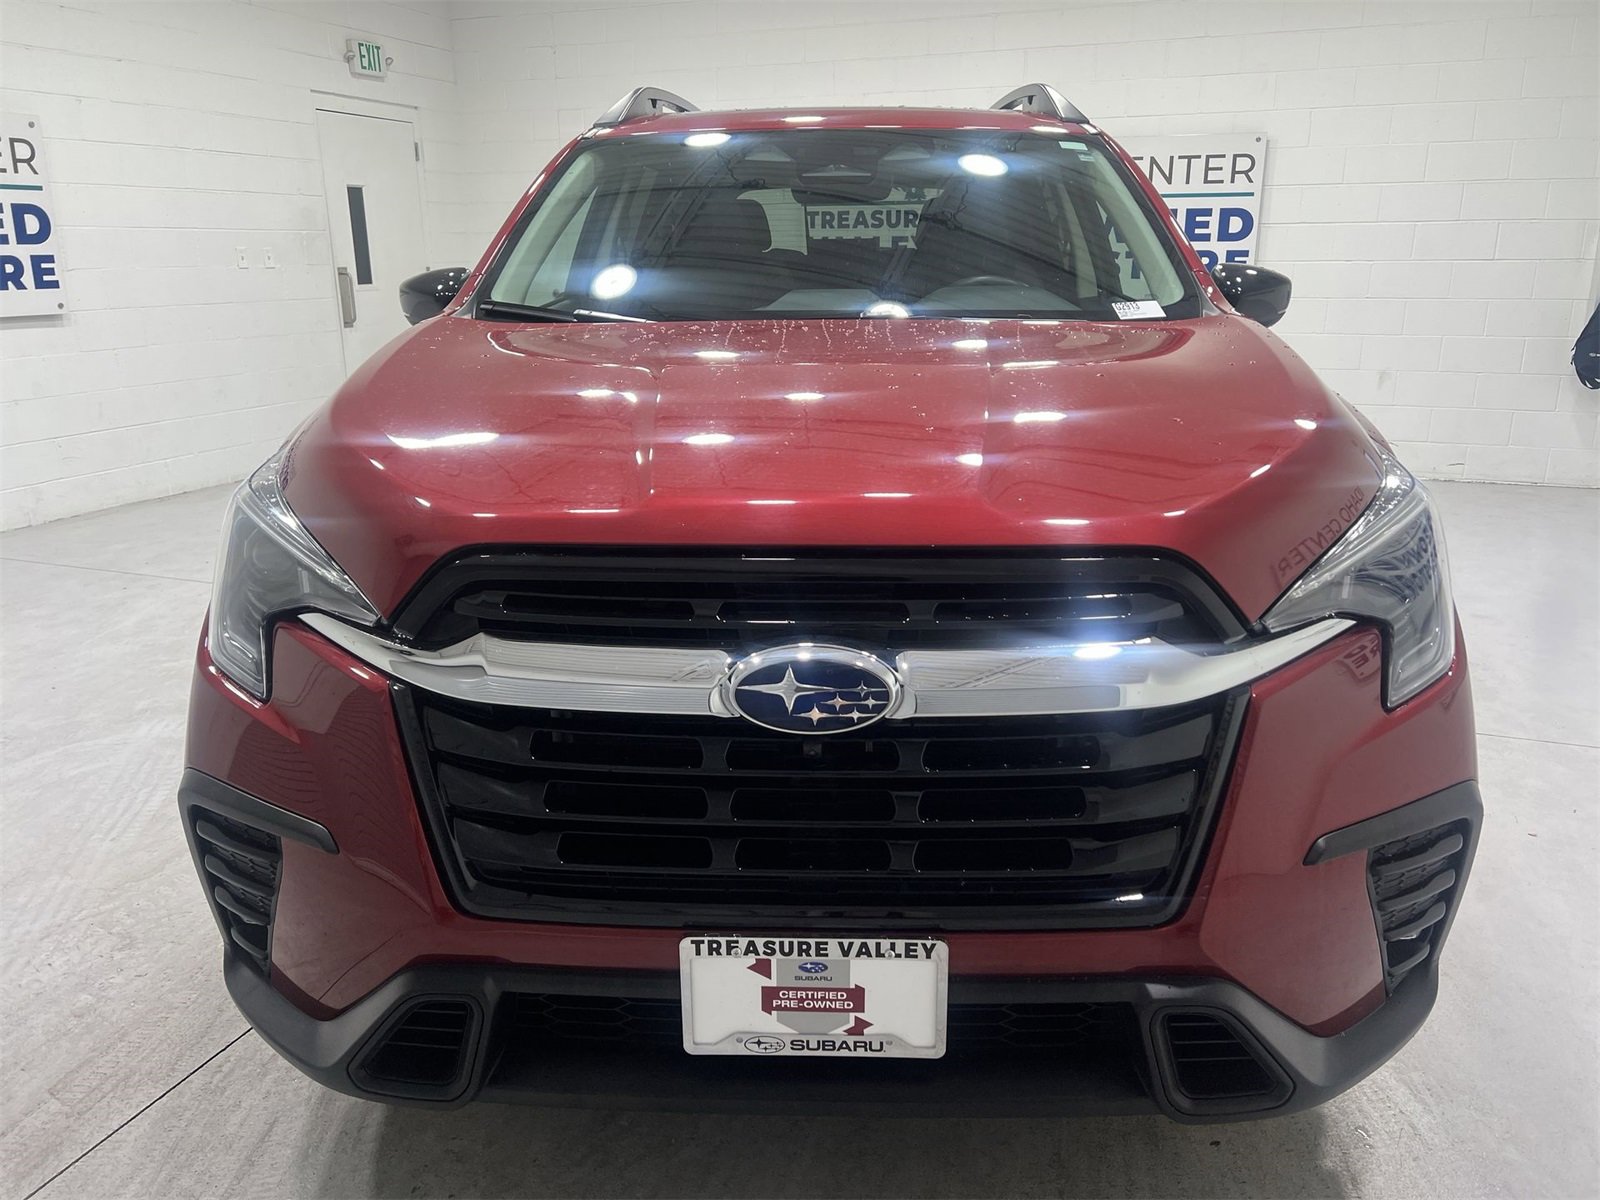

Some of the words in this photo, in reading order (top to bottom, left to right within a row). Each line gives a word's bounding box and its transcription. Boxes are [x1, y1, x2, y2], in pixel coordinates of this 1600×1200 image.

[358, 42, 381, 72] EXIT
[1133, 153, 1256, 185] NTER
[807, 210, 919, 229] TREASUR
[1170, 207, 1254, 242] ED
[690, 939, 829, 958] TREASURE
[837, 941, 937, 960] VALLEY
[772, 1000, 854, 1010] PRE-OWNED
[779, 990, 848, 1001] CERTIFIED
[789, 1039, 884, 1053] SUBARU
